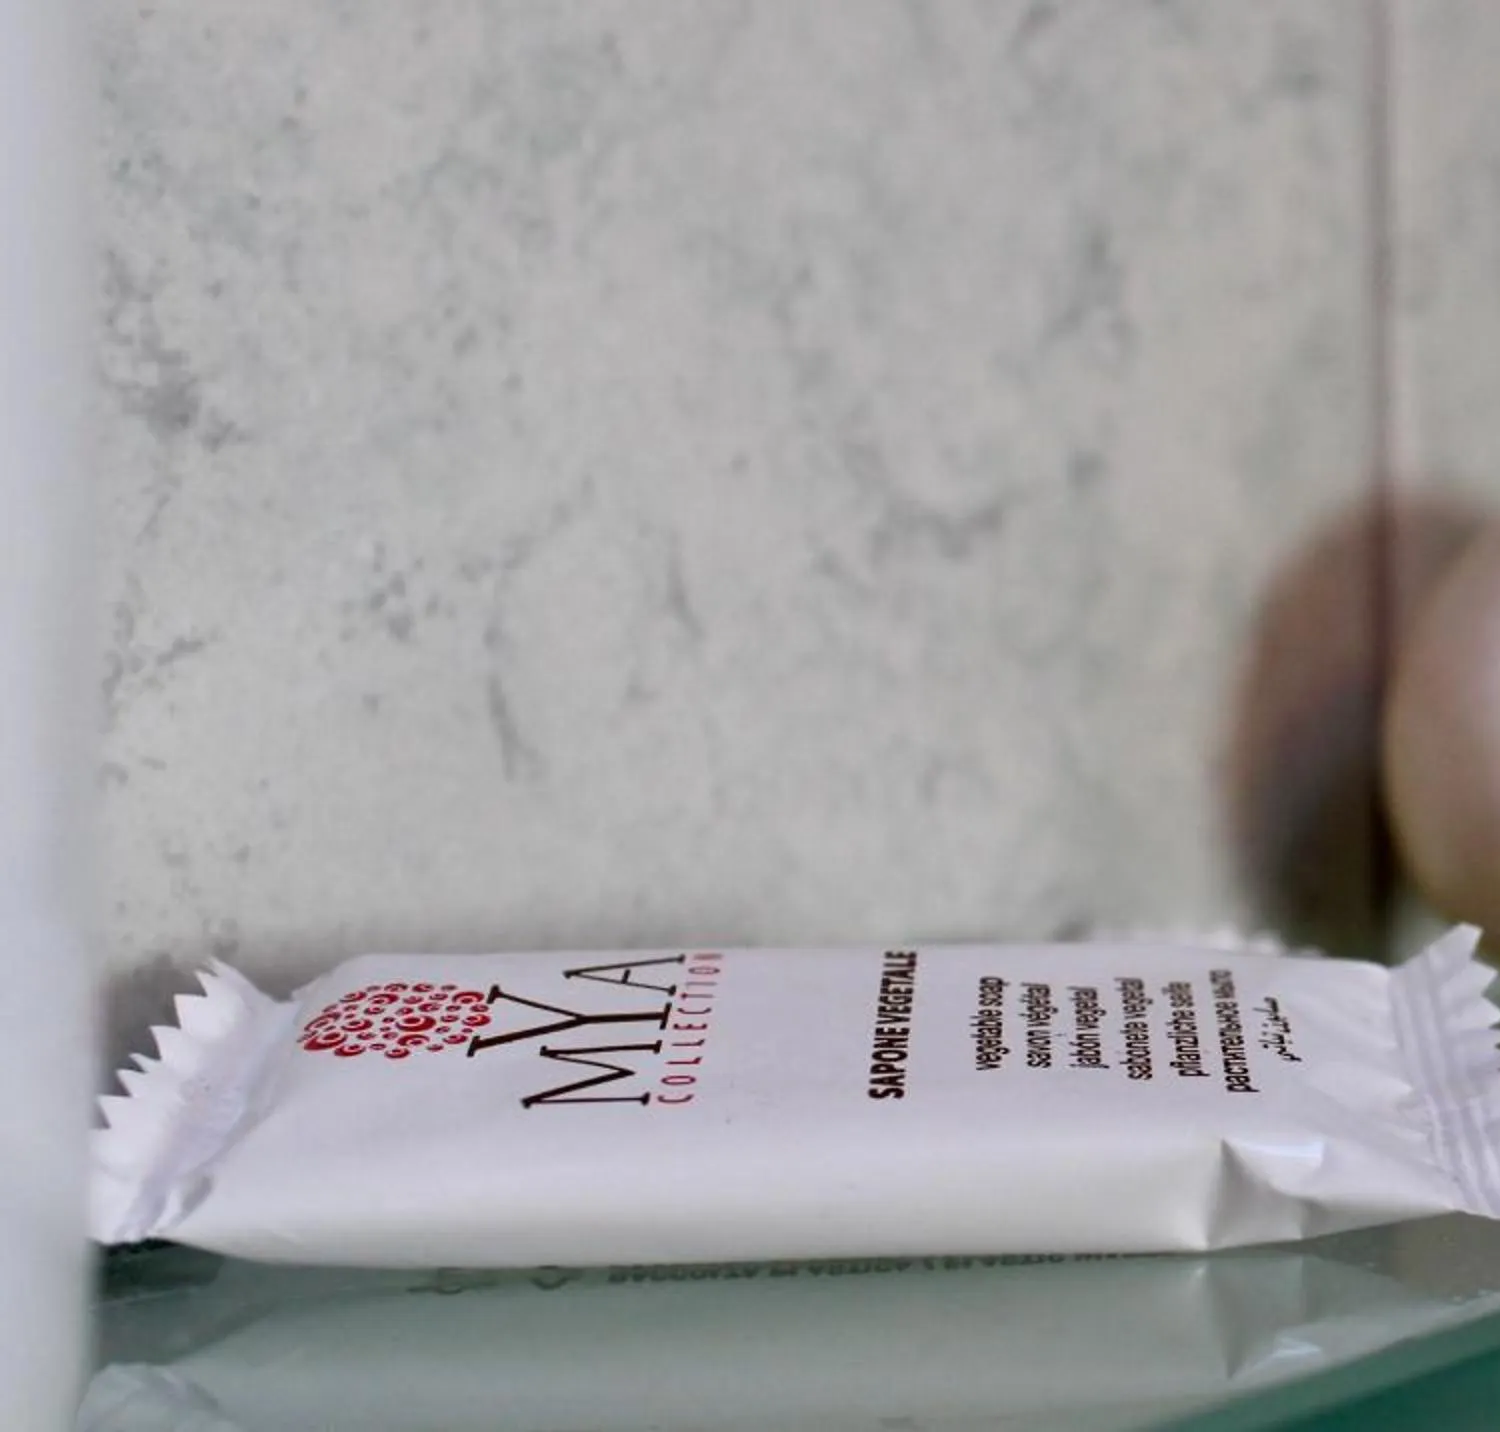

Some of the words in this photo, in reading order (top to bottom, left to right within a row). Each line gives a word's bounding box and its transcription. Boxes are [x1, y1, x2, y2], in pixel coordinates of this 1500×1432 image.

[876, 951, 917, 1025] VEGETALE
[978, 976, 1010, 1007] soap
[1017, 983, 1059, 1028] végétal
[1066, 986, 1107, 1031] vegetal
[1114, 977, 1153, 1019] vegetal
[467, 954, 685, 1108] MYA
[657, 953, 724, 1104] COLLECTION
[969, 1008, 1010, 1070] vegetable
[1026, 1029, 1052, 1069] savon
[1068, 1033, 1110, 1069] jabón
[1120, 1022, 1153, 1080] sabonete
[1164, 1010, 1210, 1077] pflanzliche
[1214, 1001, 1260, 1093] растительное
[868, 1027, 911, 1099] SAPONE
